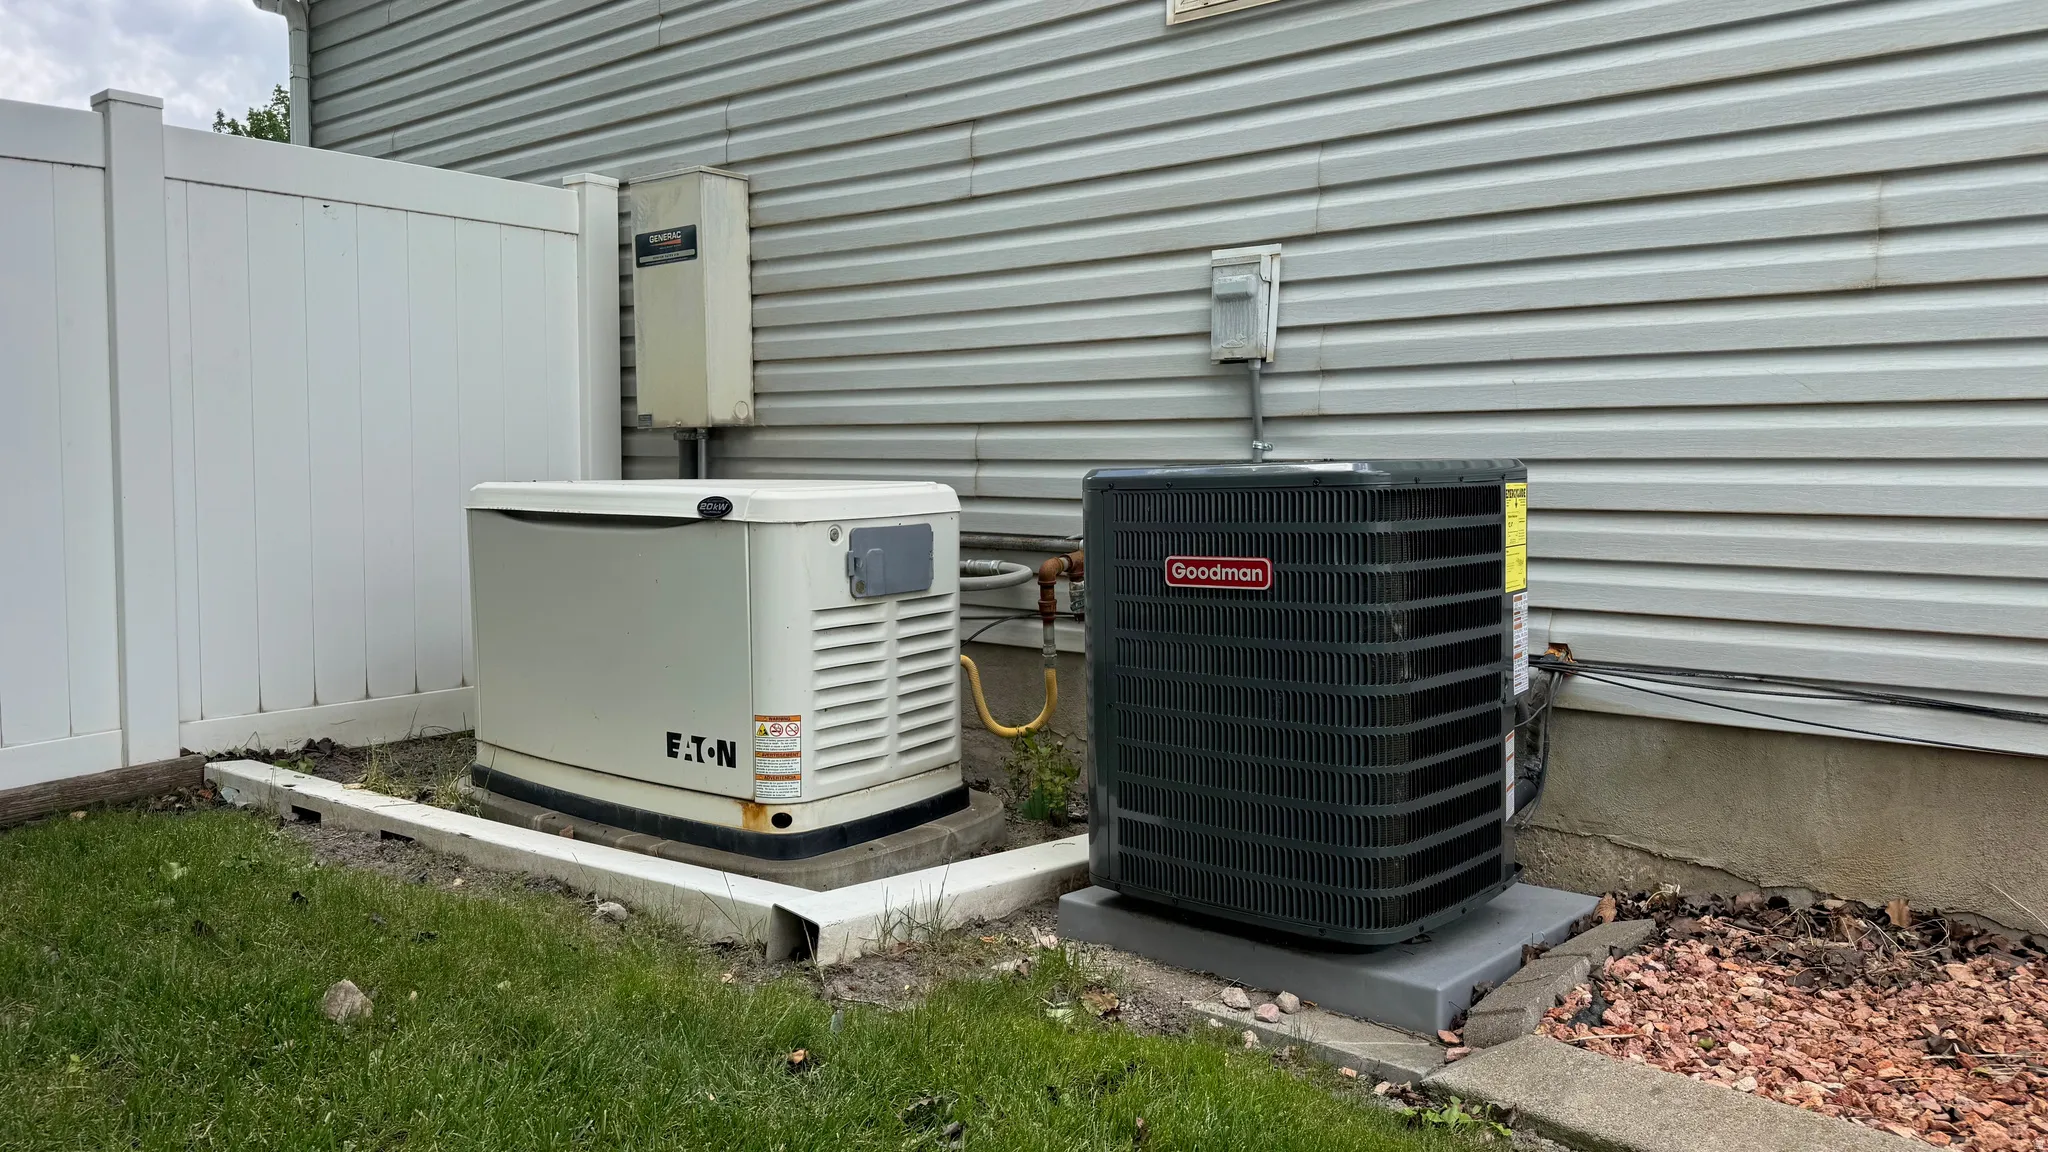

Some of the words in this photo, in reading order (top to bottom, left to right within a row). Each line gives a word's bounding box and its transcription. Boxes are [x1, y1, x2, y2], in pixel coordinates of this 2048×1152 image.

[649, 231, 682, 243] GENERAC
[1171, 562, 1263, 582] Goodman
[666, 731, 737, 769] EATON
